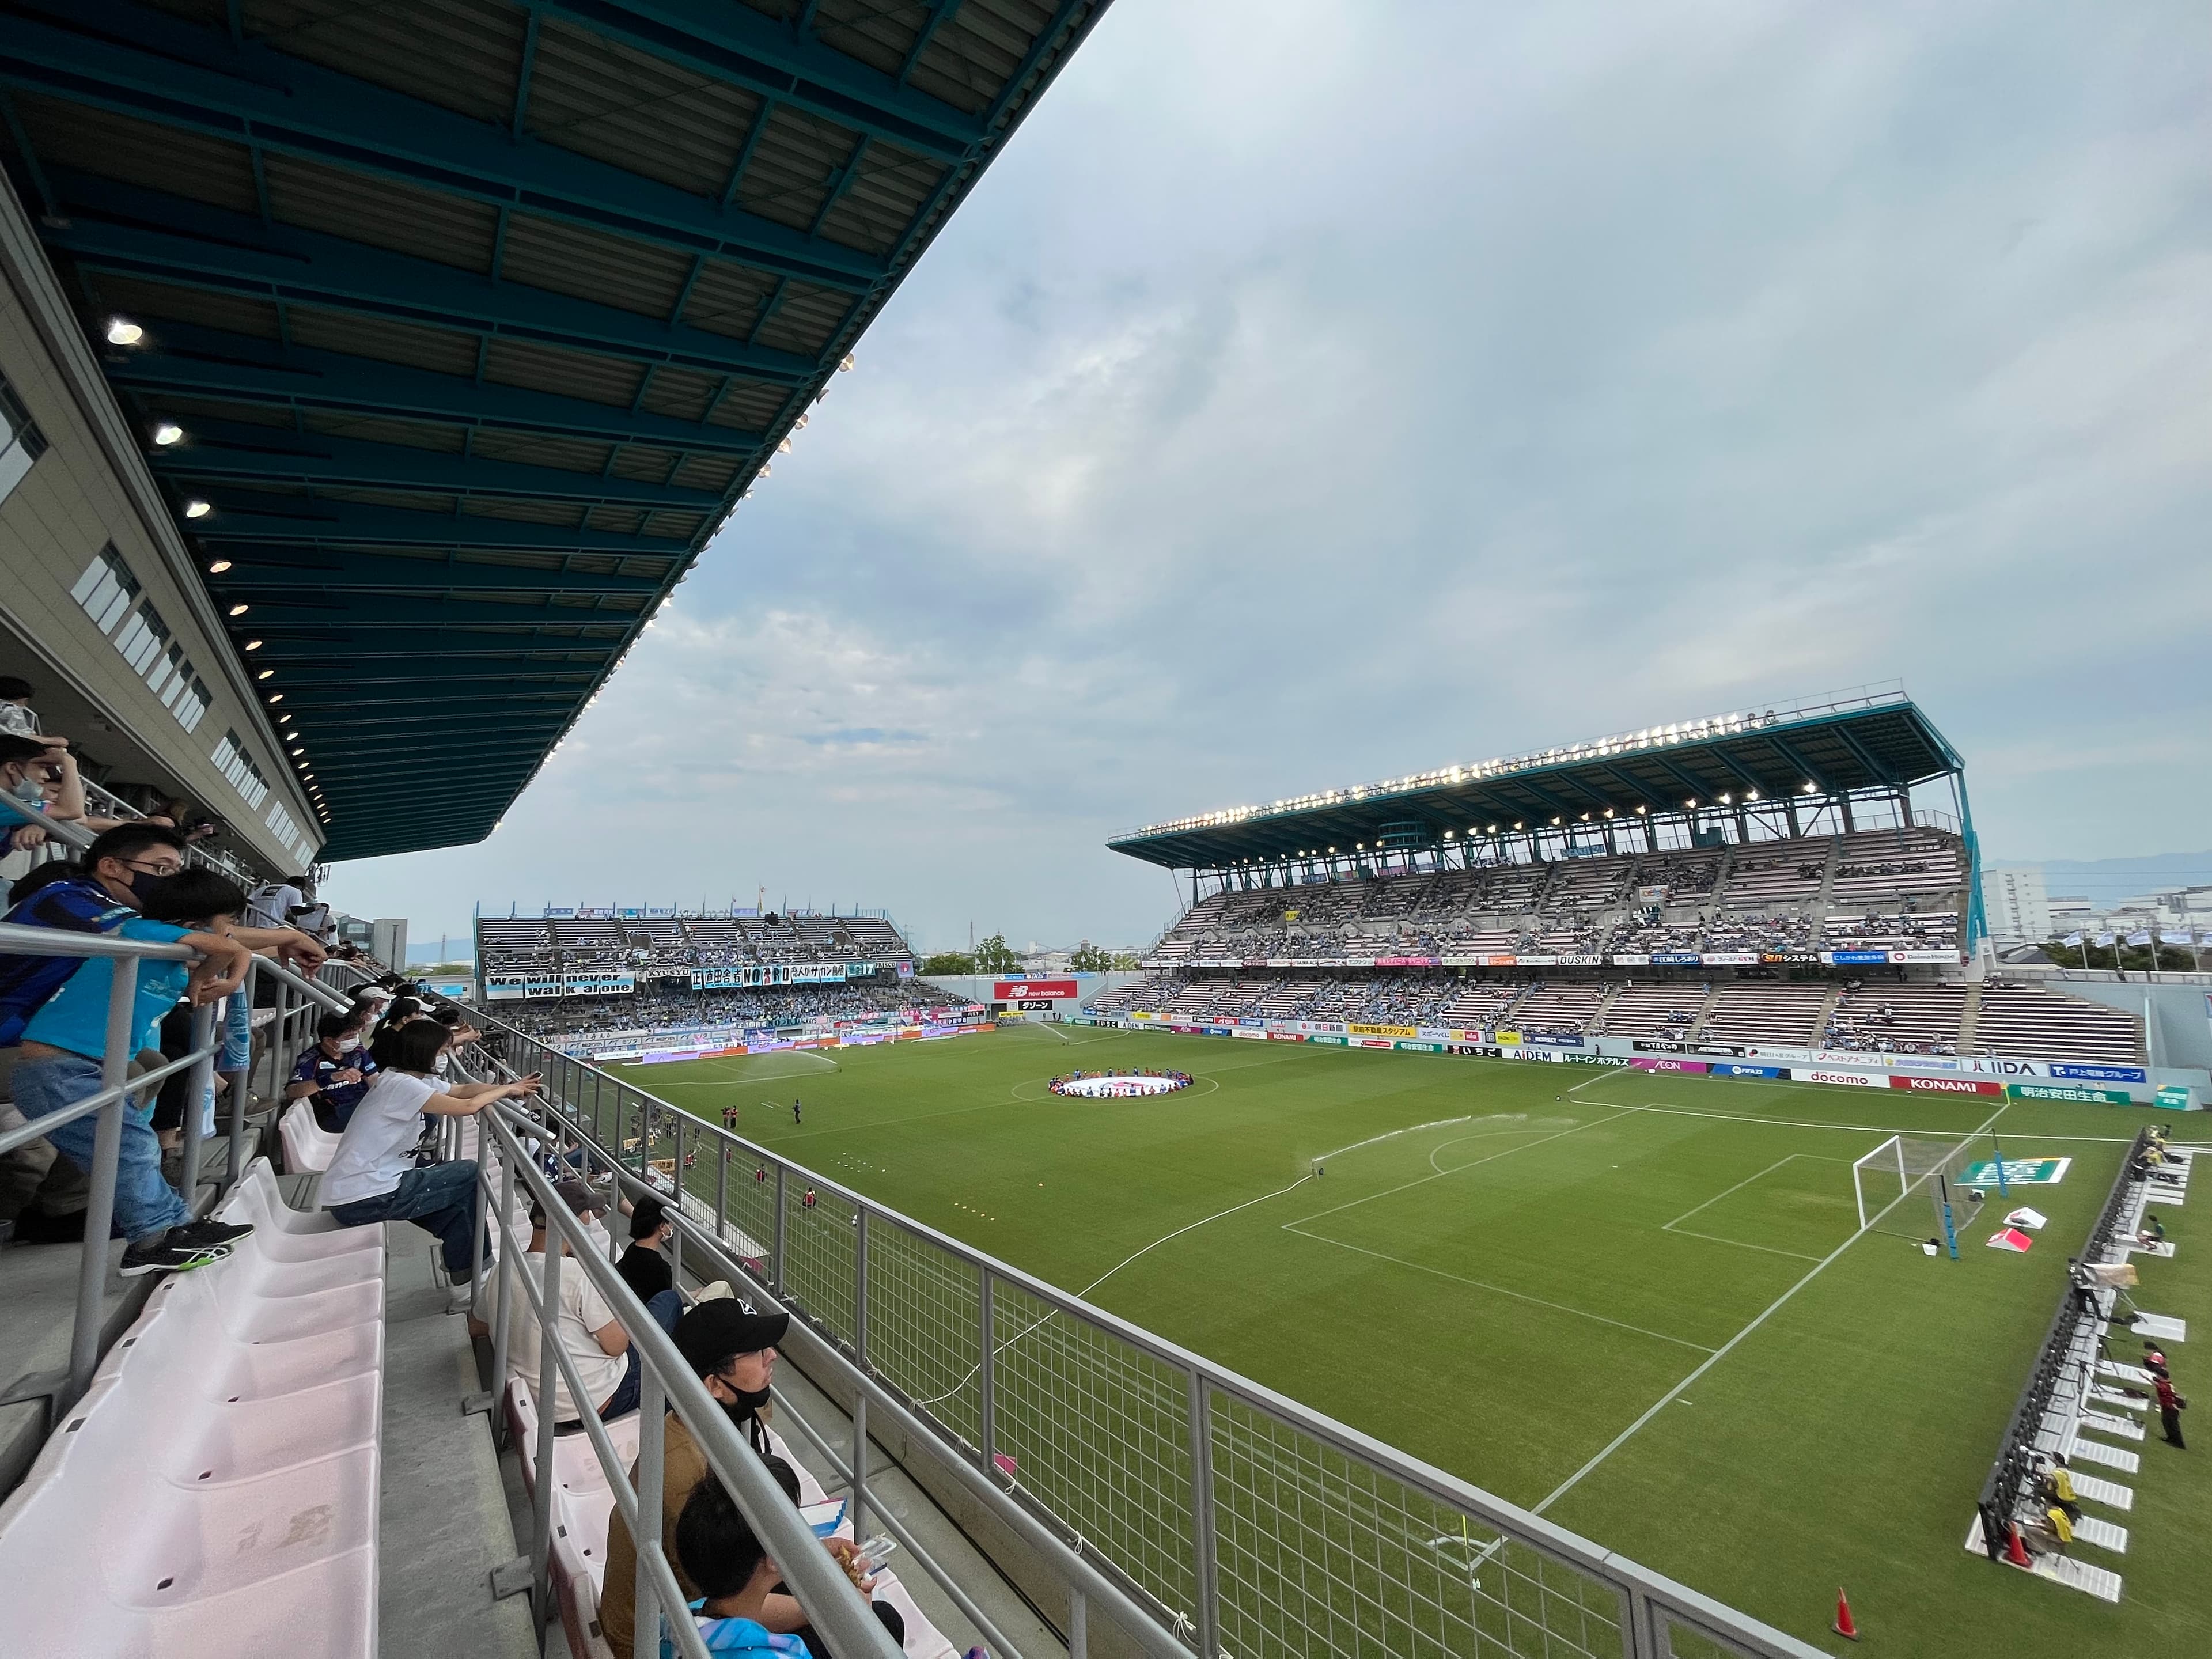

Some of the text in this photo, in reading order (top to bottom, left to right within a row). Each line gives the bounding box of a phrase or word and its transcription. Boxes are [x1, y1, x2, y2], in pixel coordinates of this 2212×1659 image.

[1560, 956, 1600, 964] DUSKIN
[490, 974, 620, 986] We will never
[692, 968, 741, 985] 正直田舎者
[528, 986, 575, 995] walk
[1353, 1025, 1411, 1036] 駅前不動産スタジアム
[1400, 1042, 1434, 1051] 明治安田生命
[1463, 1047, 1496, 1057] いちご
[1811, 1071, 1868, 1084] docomo
[1910, 1078, 1976, 1093] KONAMI
[2020, 1086, 2107, 1103] 明治安田生命
